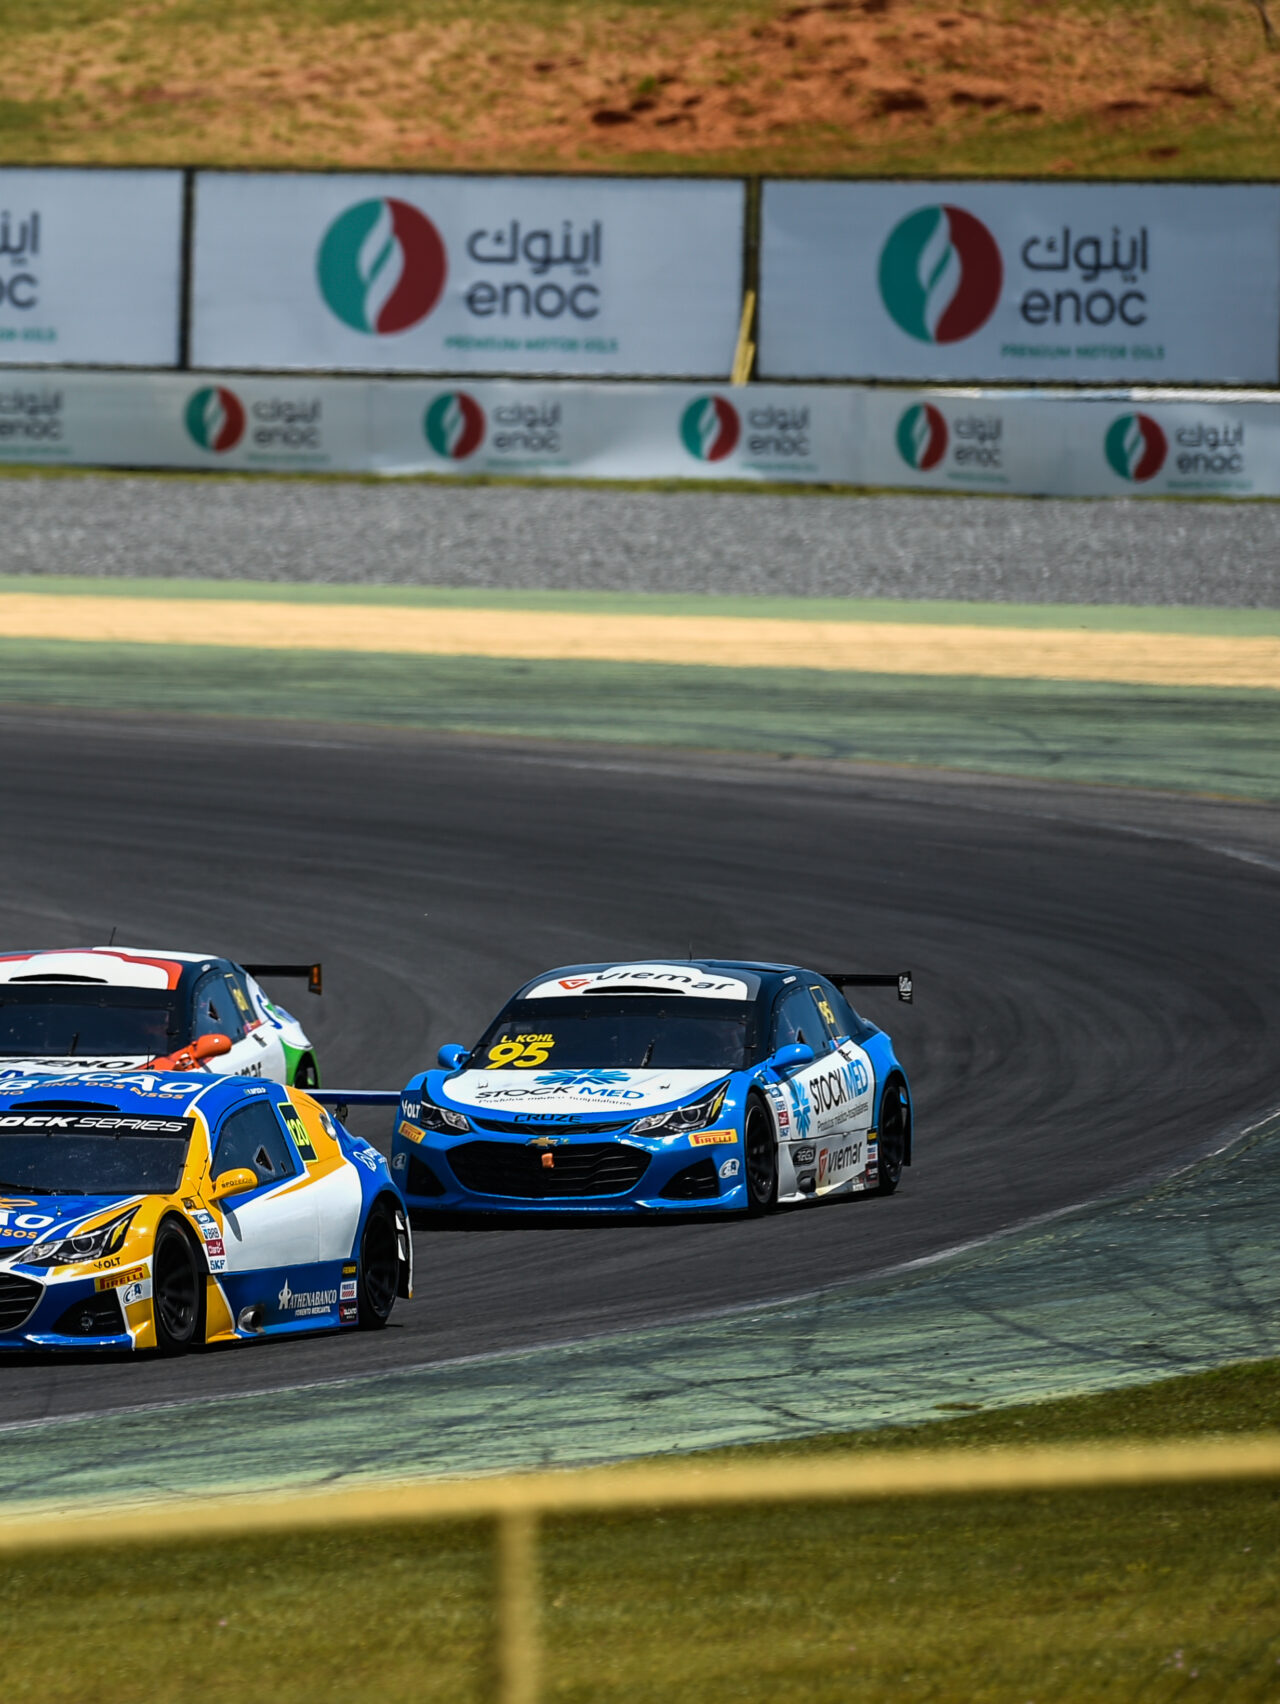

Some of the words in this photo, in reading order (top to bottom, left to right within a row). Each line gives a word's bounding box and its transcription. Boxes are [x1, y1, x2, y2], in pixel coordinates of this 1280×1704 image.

[466, 220, 602, 275] اينوك
[1021, 226, 1148, 283] اينوك
[465, 281, 600, 319] enoc
[1020, 289, 1146, 325] enoc
[252, 425, 320, 448] enoc
[494, 430, 561, 454] enoc
[748, 433, 810, 457] enoc
[954, 444, 1001, 468] enoc
[1176, 450, 1243, 474] enoc
[595, 970, 735, 993] viemar
[516, 1033, 554, 1043] KOHL
[485, 1042, 556, 1070] 95
[85, 1082, 125, 1090] DOS
[475, 1086, 573, 1099] STOCK
[578, 1087, 645, 1099] MED
[809, 1069, 846, 1116] STOCK
[841, 1059, 869, 1101] MED
[402, 1100, 421, 1118] VOLT
[514, 1114, 584, 1123] CRUZE
[75, 1117, 187, 1132] SERIES
[286, 1117, 311, 1147] 120
[693, 1131, 732, 1145] PIRELLI
[828, 1142, 863, 1173] viemar
[94, 1257, 120, 1270] VOLT
[210, 1260, 225, 1270] SKF
[100, 1266, 144, 1289] PIRELLI
